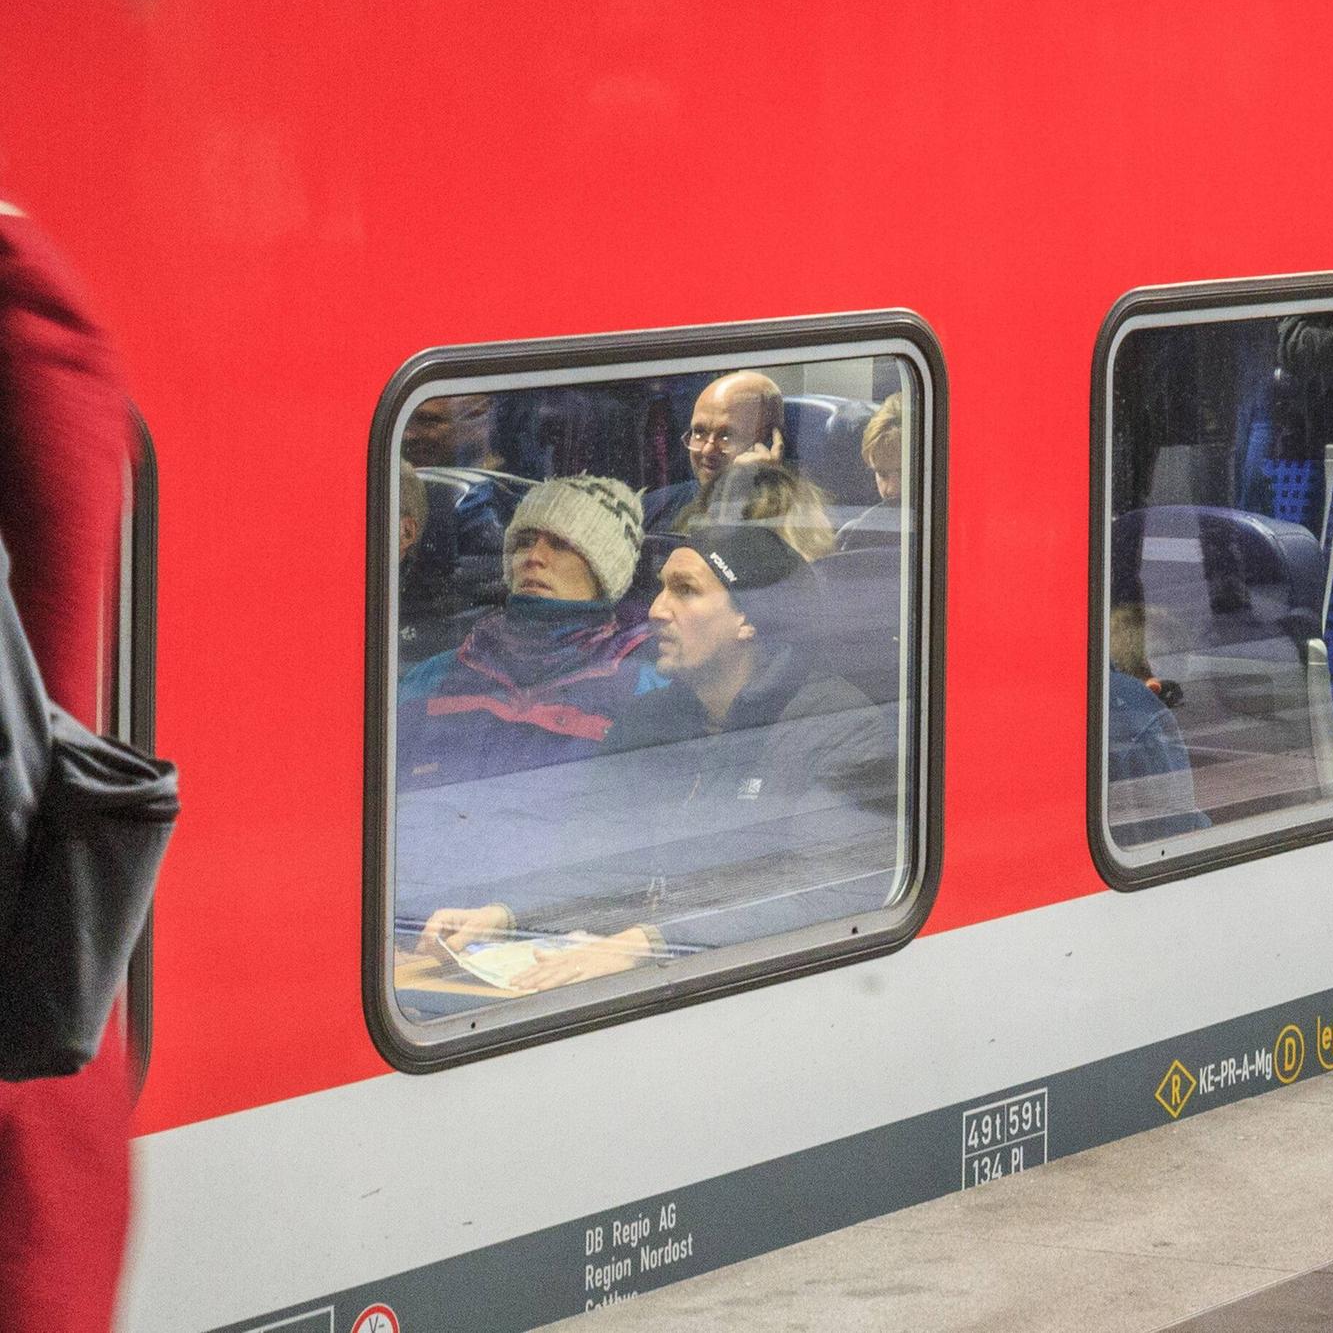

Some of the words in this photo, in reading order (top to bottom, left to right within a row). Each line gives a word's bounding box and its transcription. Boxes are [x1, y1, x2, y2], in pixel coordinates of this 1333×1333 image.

[1171, 1074, 1182, 1105] R
[1200, 1047, 1273, 1095] KE-PR-A-Mg
[1284, 1037, 1297, 1071] D
[967, 1113, 1001, 1149] 49t
[1009, 1101, 1041, 1135] 59t
[972, 1152, 1003, 1187] 134
[585, 1226, 603, 1257] DB
[612, 1213, 650, 1247] Regio
[658, 1202, 676, 1232] AG
[585, 1255, 632, 1292] Region
[640, 1232, 693, 1273] Nordost
